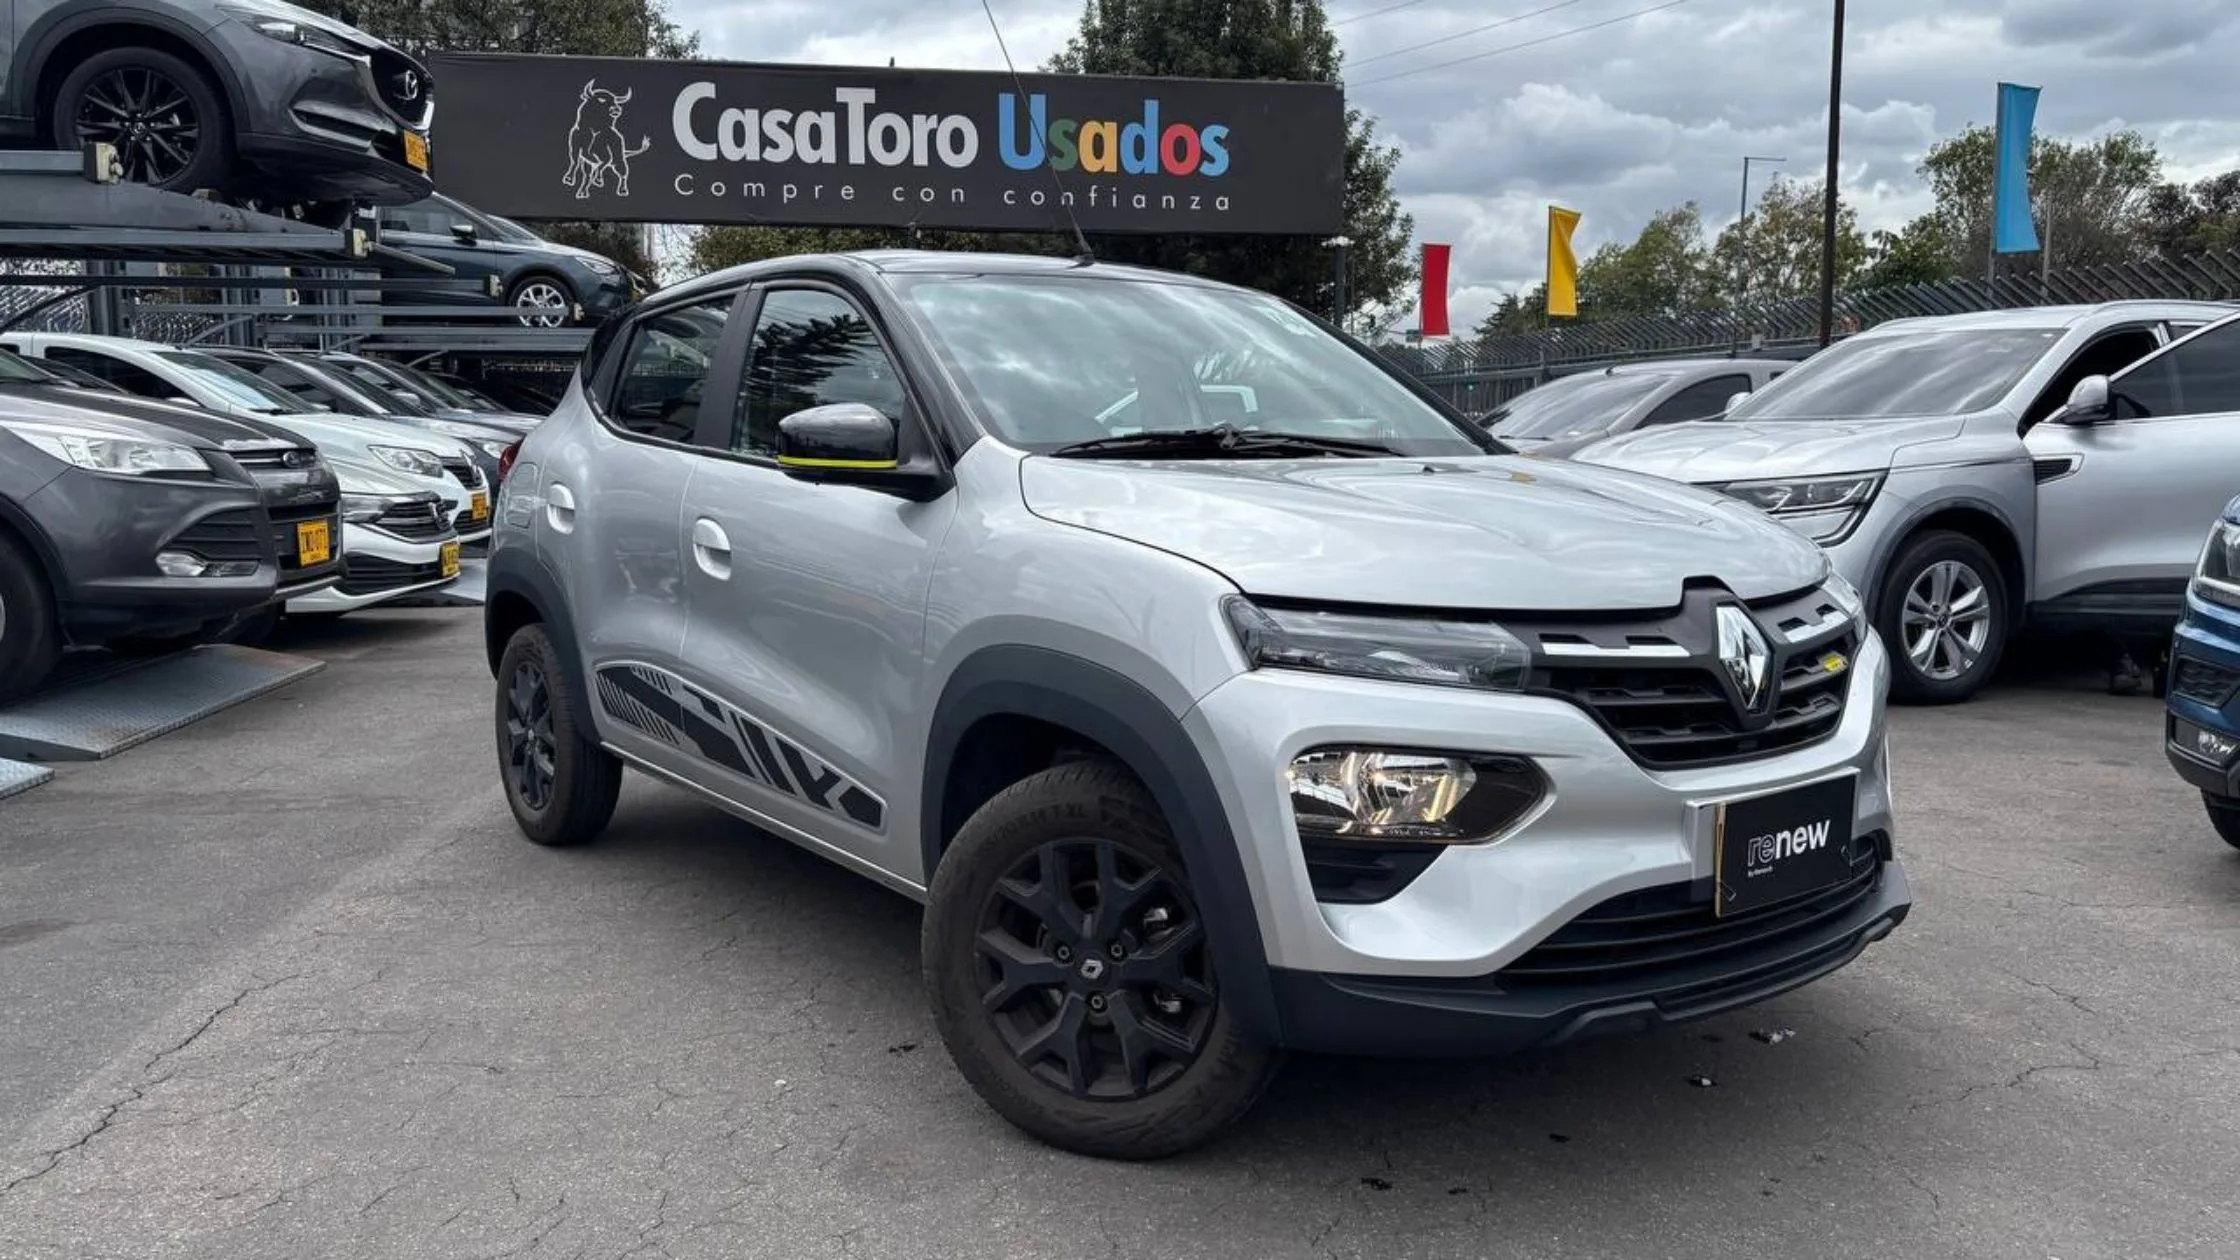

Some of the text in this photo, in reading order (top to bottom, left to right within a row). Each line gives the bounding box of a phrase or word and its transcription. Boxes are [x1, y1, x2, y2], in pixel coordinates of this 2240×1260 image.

[672, 81, 1230, 177] CasaToro Usados
[674, 174, 1230, 211] Compre con confianza
[1747, 819, 1831, 867] renew
